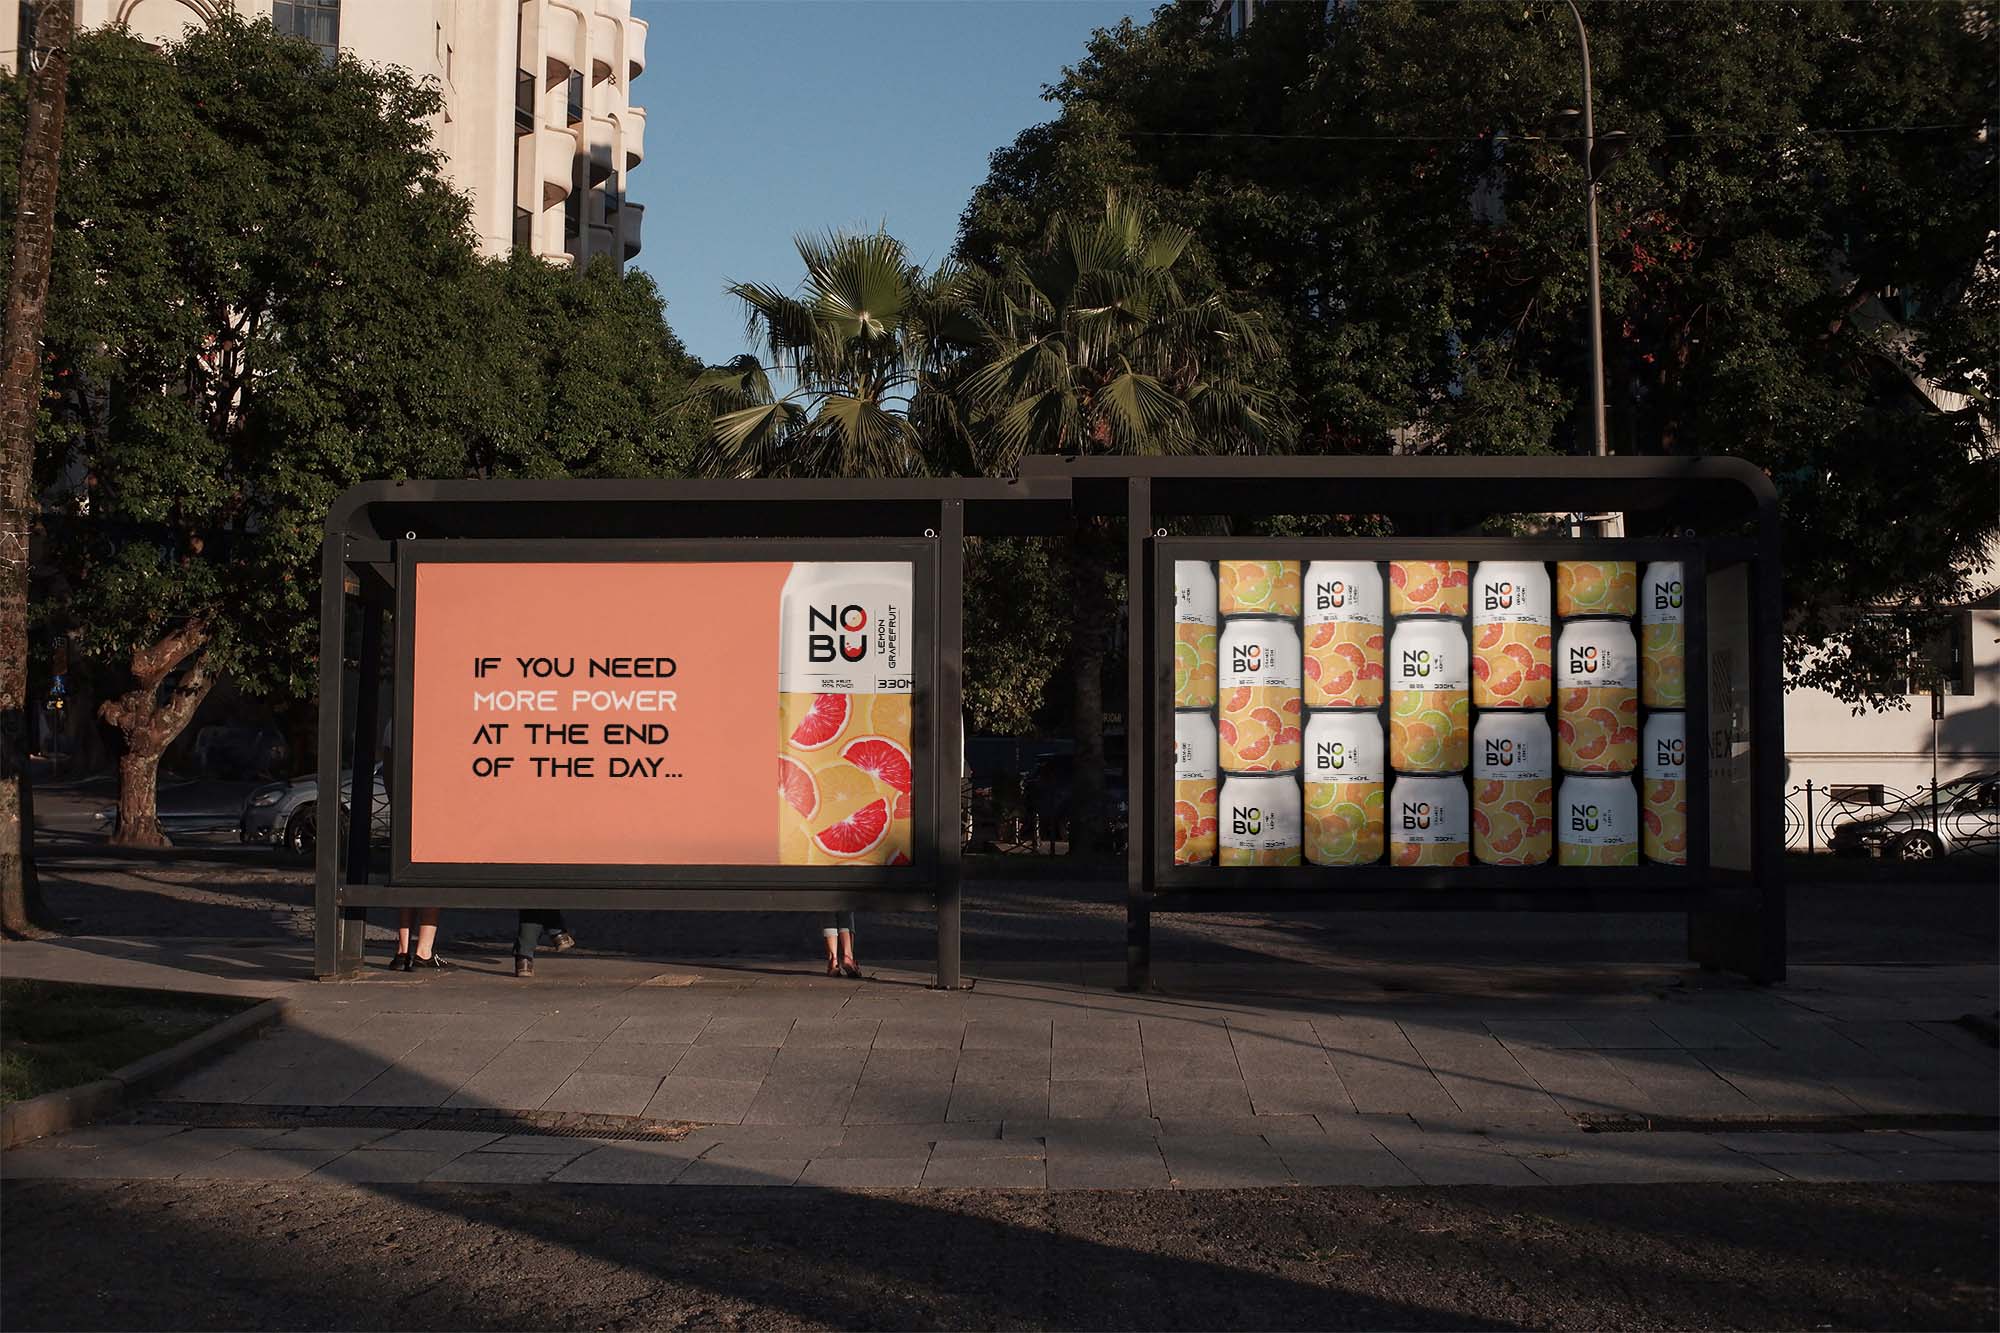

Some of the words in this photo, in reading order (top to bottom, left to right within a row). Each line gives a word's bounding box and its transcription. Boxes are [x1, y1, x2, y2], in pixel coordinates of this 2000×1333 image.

[808, 604, 867, 632] NO
[808, 634, 867, 663] BU
[878, 619, 886, 655] LEMON
[888, 604, 897, 669] GRAPEFRUIT
[474, 657, 501, 678] IF
[516, 657, 575, 678] YOU
[589, 657, 677, 678] NEED
[473, 690, 558, 712] MORE
[572, 690, 678, 712] POWER
[472, 723, 509, 745] AT
[524, 723, 589, 745] THE
[603, 723, 669, 745] END
[472, 757, 515, 778] OF
[529, 757, 595, 778] THE
[609, 757, 683, 778] DAY...
